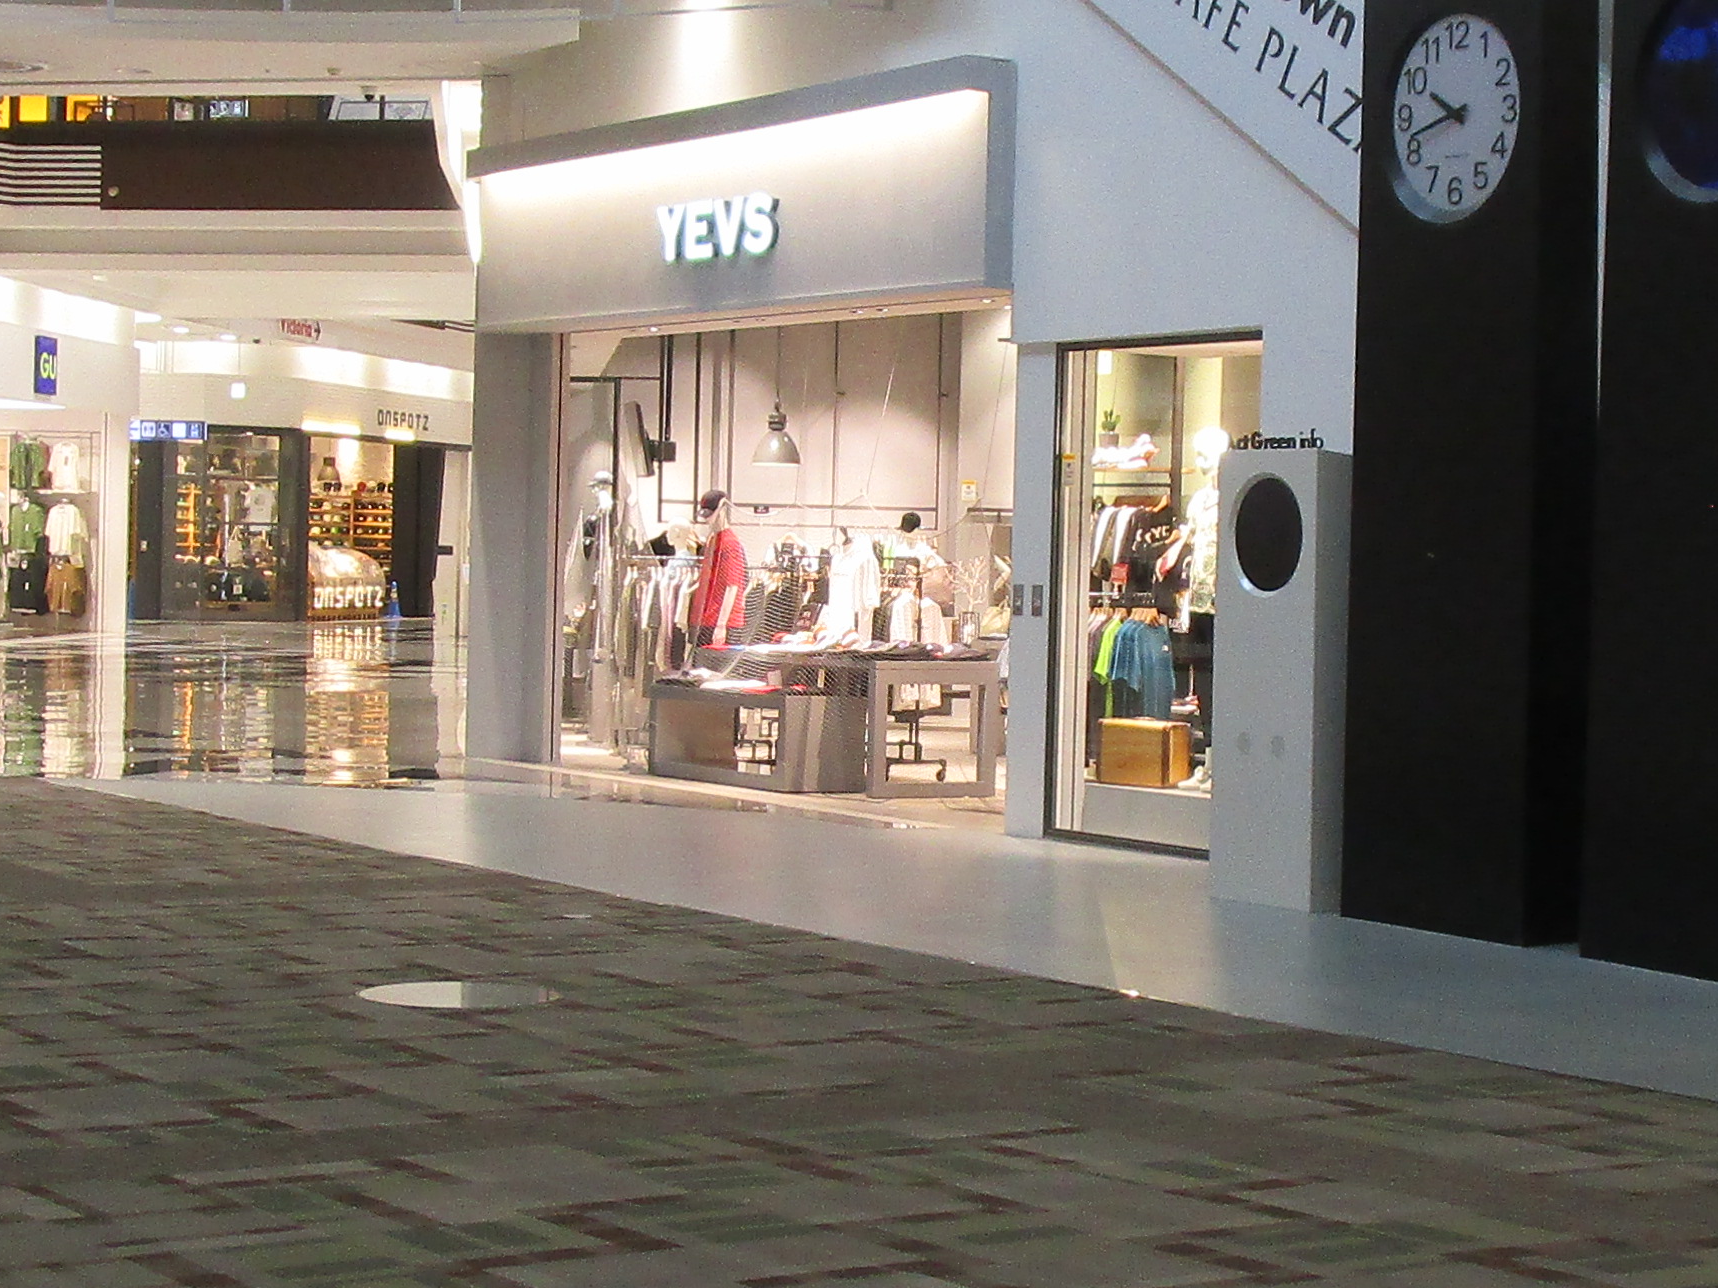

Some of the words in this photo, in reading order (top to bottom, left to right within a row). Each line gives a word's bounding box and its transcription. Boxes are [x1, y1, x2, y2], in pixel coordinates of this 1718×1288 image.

[1445, 20, 1471, 50] 12
[1479, 30, 1489, 58] 1
[1421, 36, 1440, 64] 11
[1403, 66, 1428, 95] 10
[1494, 58, 1511, 87] 2
[1255, 26, 1363, 154] PLAZ
[1397, 103, 1413, 132] 9
[1501, 94, 1518, 124] 3
[1406, 136, 1422, 165] 8
[1490, 131, 1507, 159] 4
[1425, 165, 1440, 193] 7
[1446, 176, 1463, 205] 6
[1472, 162, 1489, 191] 5
[656, 191, 781, 262] YEVS
[40, 352, 57, 380] GU
